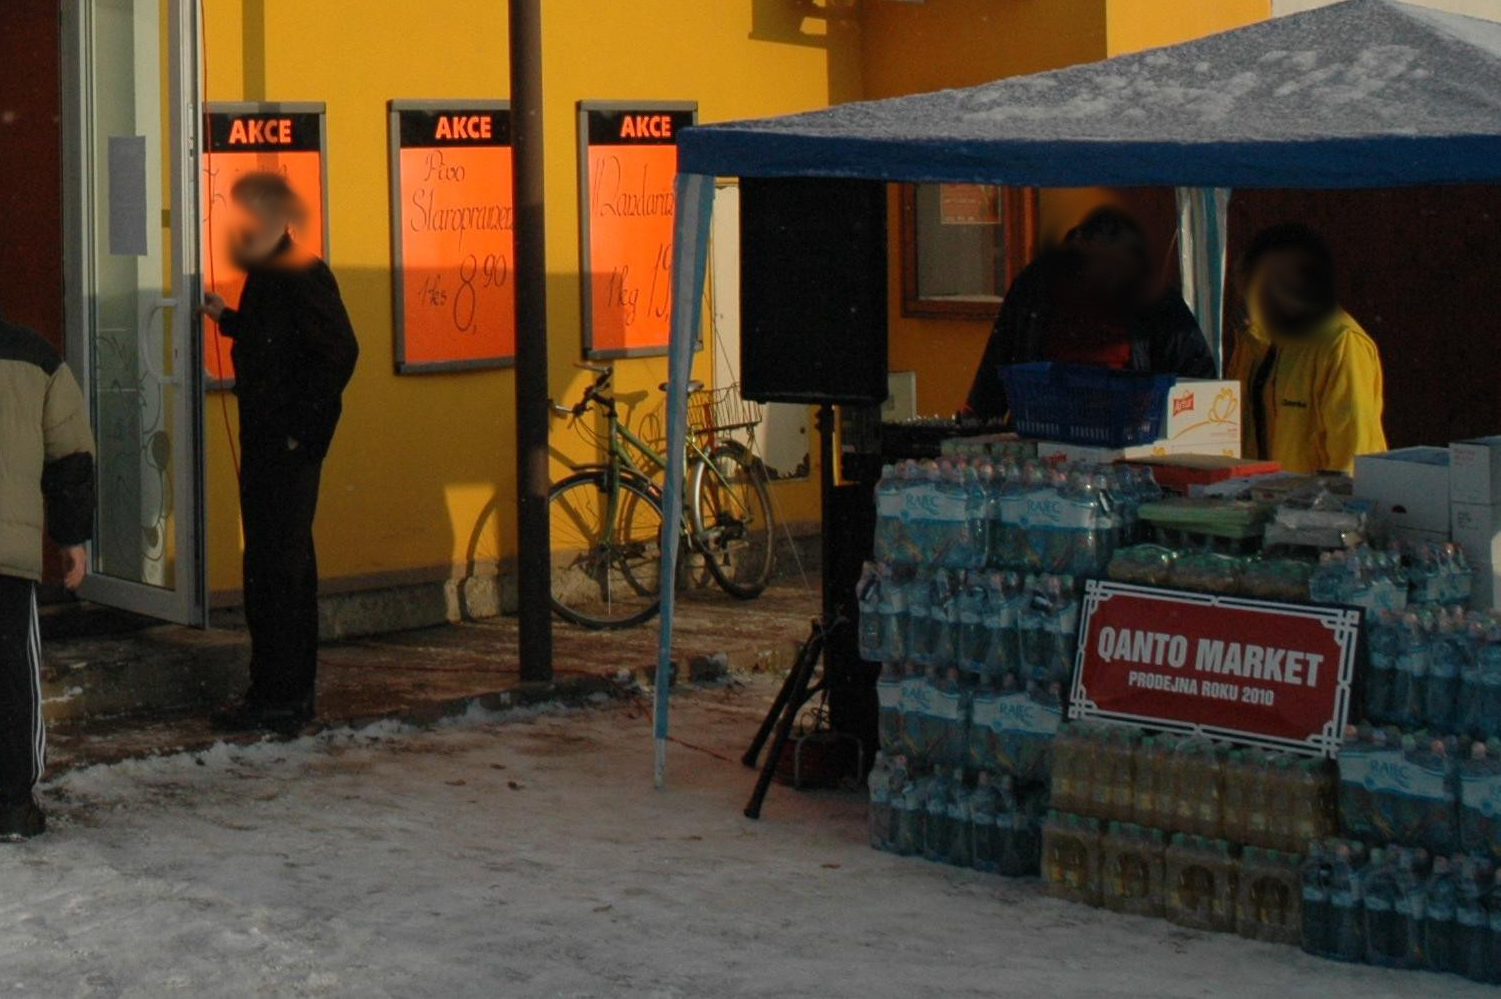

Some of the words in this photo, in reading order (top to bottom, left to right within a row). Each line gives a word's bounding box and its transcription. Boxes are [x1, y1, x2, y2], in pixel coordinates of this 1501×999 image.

[228, 119, 292, 144] AKCE
[435, 116, 492, 140] AKCE
[620, 115, 672, 138] AKCE
[1097, 626, 1188, 668] QANTO
[1195, 638, 1324, 688] MARKET
[1129, 671, 1198, 695] PRODEJNA
[1201, 681, 1238, 701] ROKU
[1241, 686, 1275, 707] 2010
